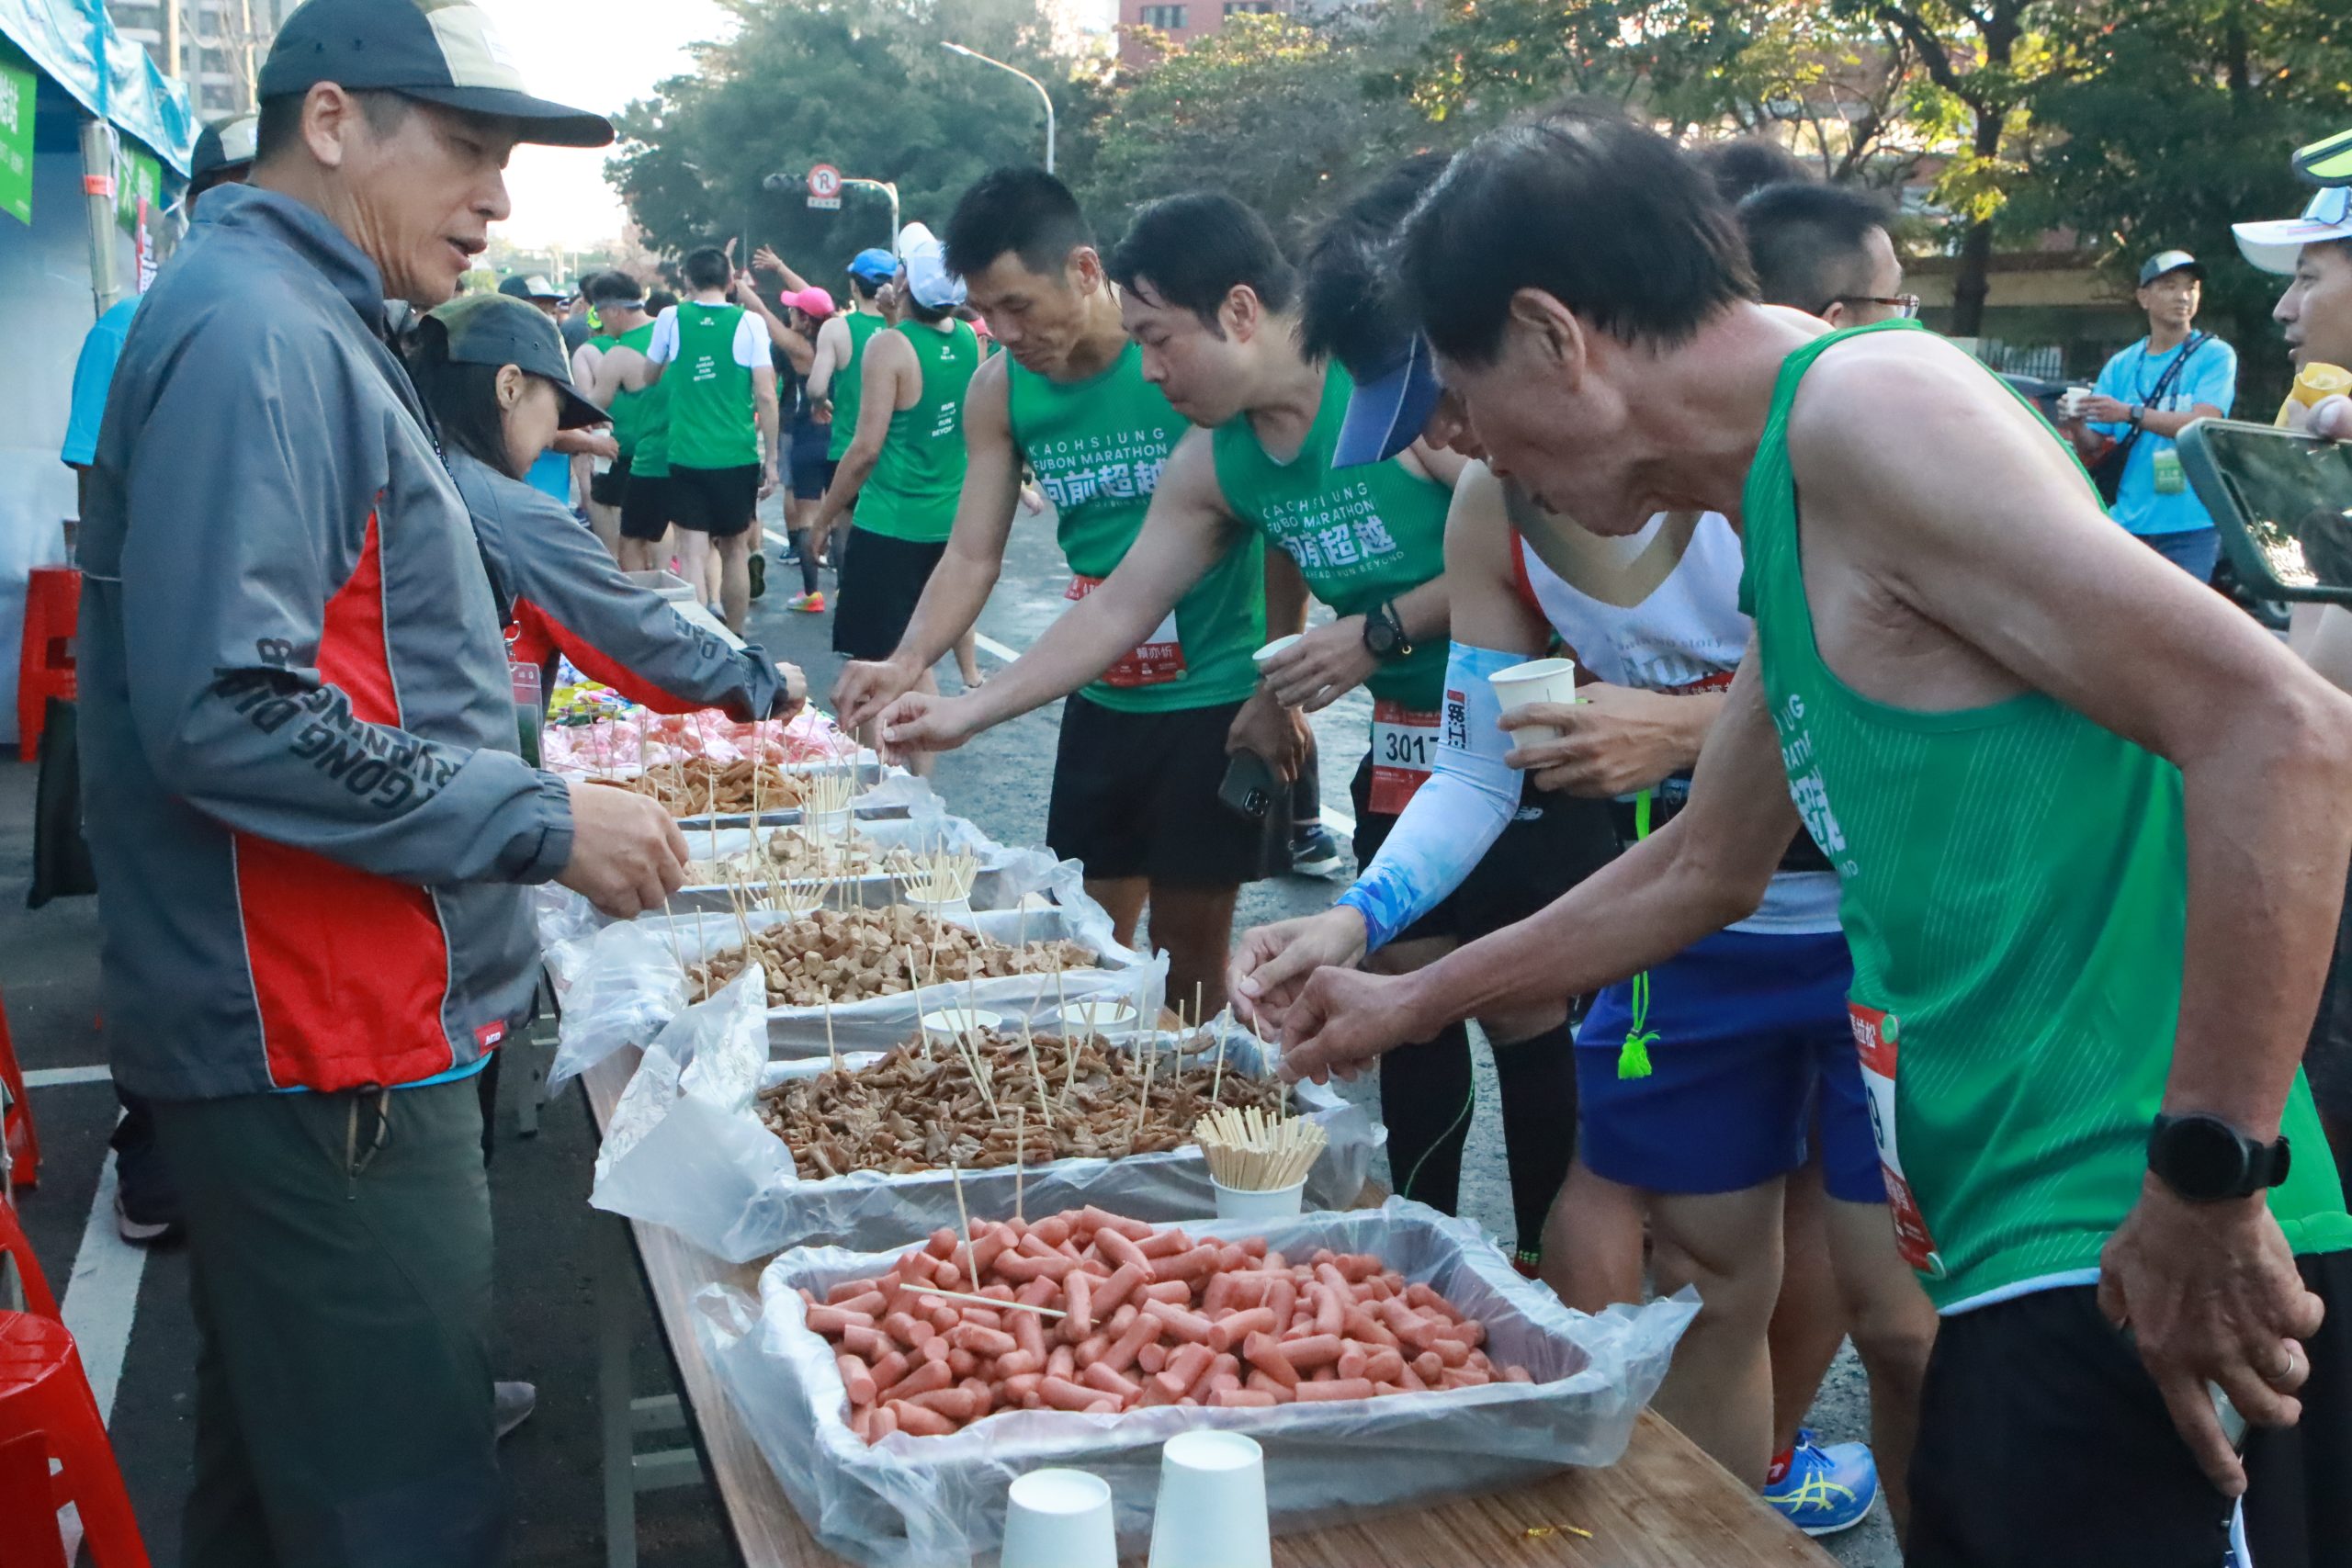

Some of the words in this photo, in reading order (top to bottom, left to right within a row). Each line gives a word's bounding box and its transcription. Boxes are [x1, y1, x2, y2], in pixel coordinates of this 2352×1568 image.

[1028, 427, 1165, 457] KAOHSIUNG
[1033, 456, 1076, 471] FUBON
[1080, 443, 1168, 466] MARATHON
[1304, 500, 1375, 528] MARATHON
